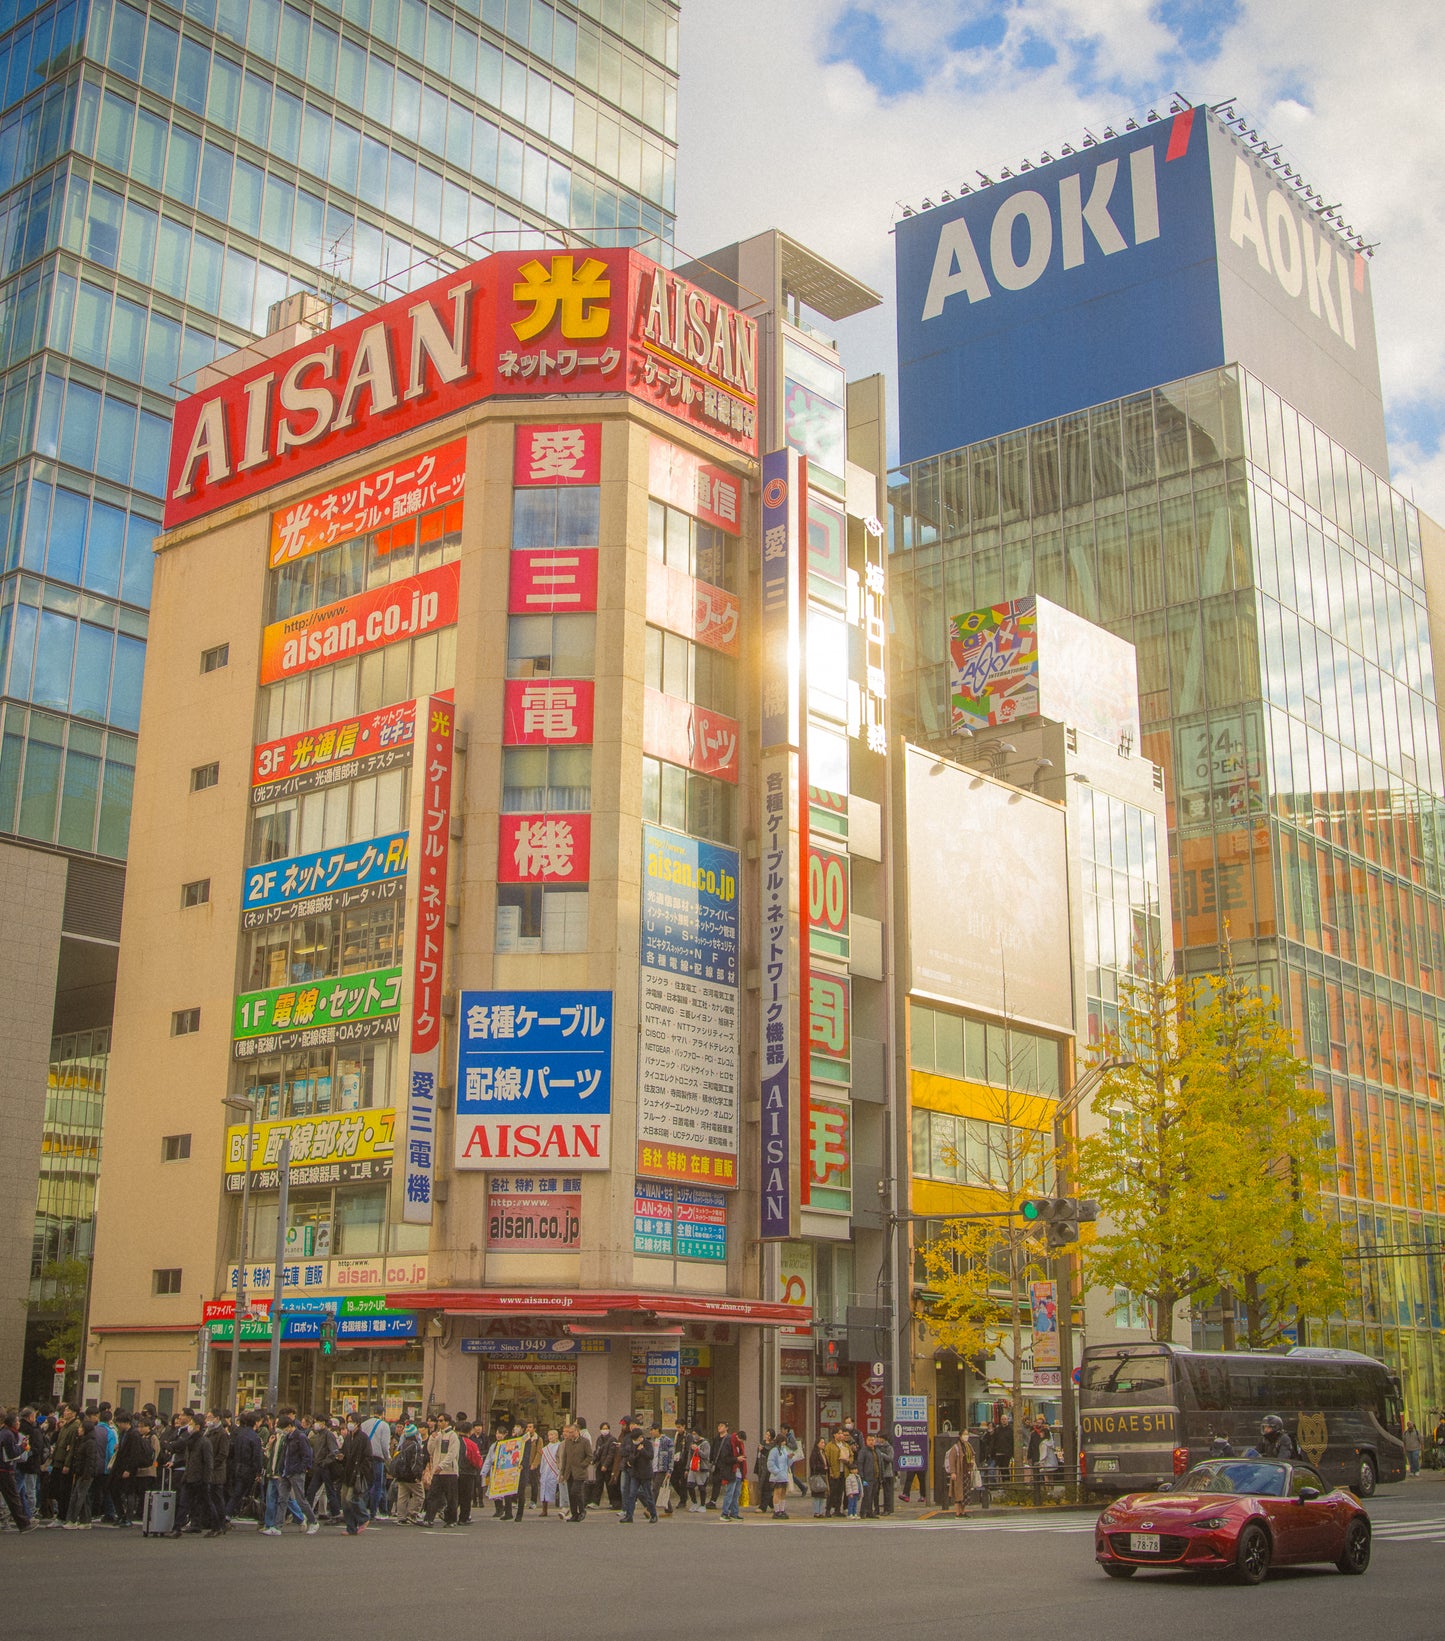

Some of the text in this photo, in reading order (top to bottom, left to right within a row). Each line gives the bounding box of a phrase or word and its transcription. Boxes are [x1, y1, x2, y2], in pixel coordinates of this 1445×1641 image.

[921, 145, 1161, 322] AOKI
[1230, 155, 1356, 350] AOKI
[511, 255, 611, 341] 光
[644, 267, 757, 395] AISAN
[499, 346, 621, 377] ネットワーク
[172, 280, 473, 500] AISAN
[282, 590, 439, 670] aisan.co.jp
[284, 605, 349, 635] http://www.
[988, 665, 1029, 679] INTERNATIONAL
[258, 745, 286, 776] 3F
[248, 872, 277, 901] 2F
[416, 711, 450, 1036] 光・ケーブル・ネットワーク
[647, 851, 736, 902] aisan.co.jp
[766, 772, 784, 1065] 各種ケーブル・ネットワーク機器
[241, 999, 267, 1028] 1F
[466, 1004, 606, 1039] 各種ケーブル
[465, 1066, 602, 1101] 配線パーツ
[407, 1070, 434, 1204] 愛三電機
[461, 1124, 601, 1158] AISAN
[766, 1085, 784, 1220] AISAN
[642, 1147, 733, 1178] 各社 特約 在庫 直販
[490, 1177, 581, 1193] 各社 特約 在庫 直販
[490, 1209, 580, 1244] aisan.co.jp
[253, 1267, 271, 1288] 特約
[305, 1265, 323, 1286] 直販
[500, 1296, 573, 1306] www.aisan.co.jp
[705, 1302, 752, 1313] www.aisan.co.jp
[519, 1340, 547, 1351] 1949
[1082, 1413, 1175, 1434] ONGAESHI
[1137, 1540, 1159, 1551] 78-78
